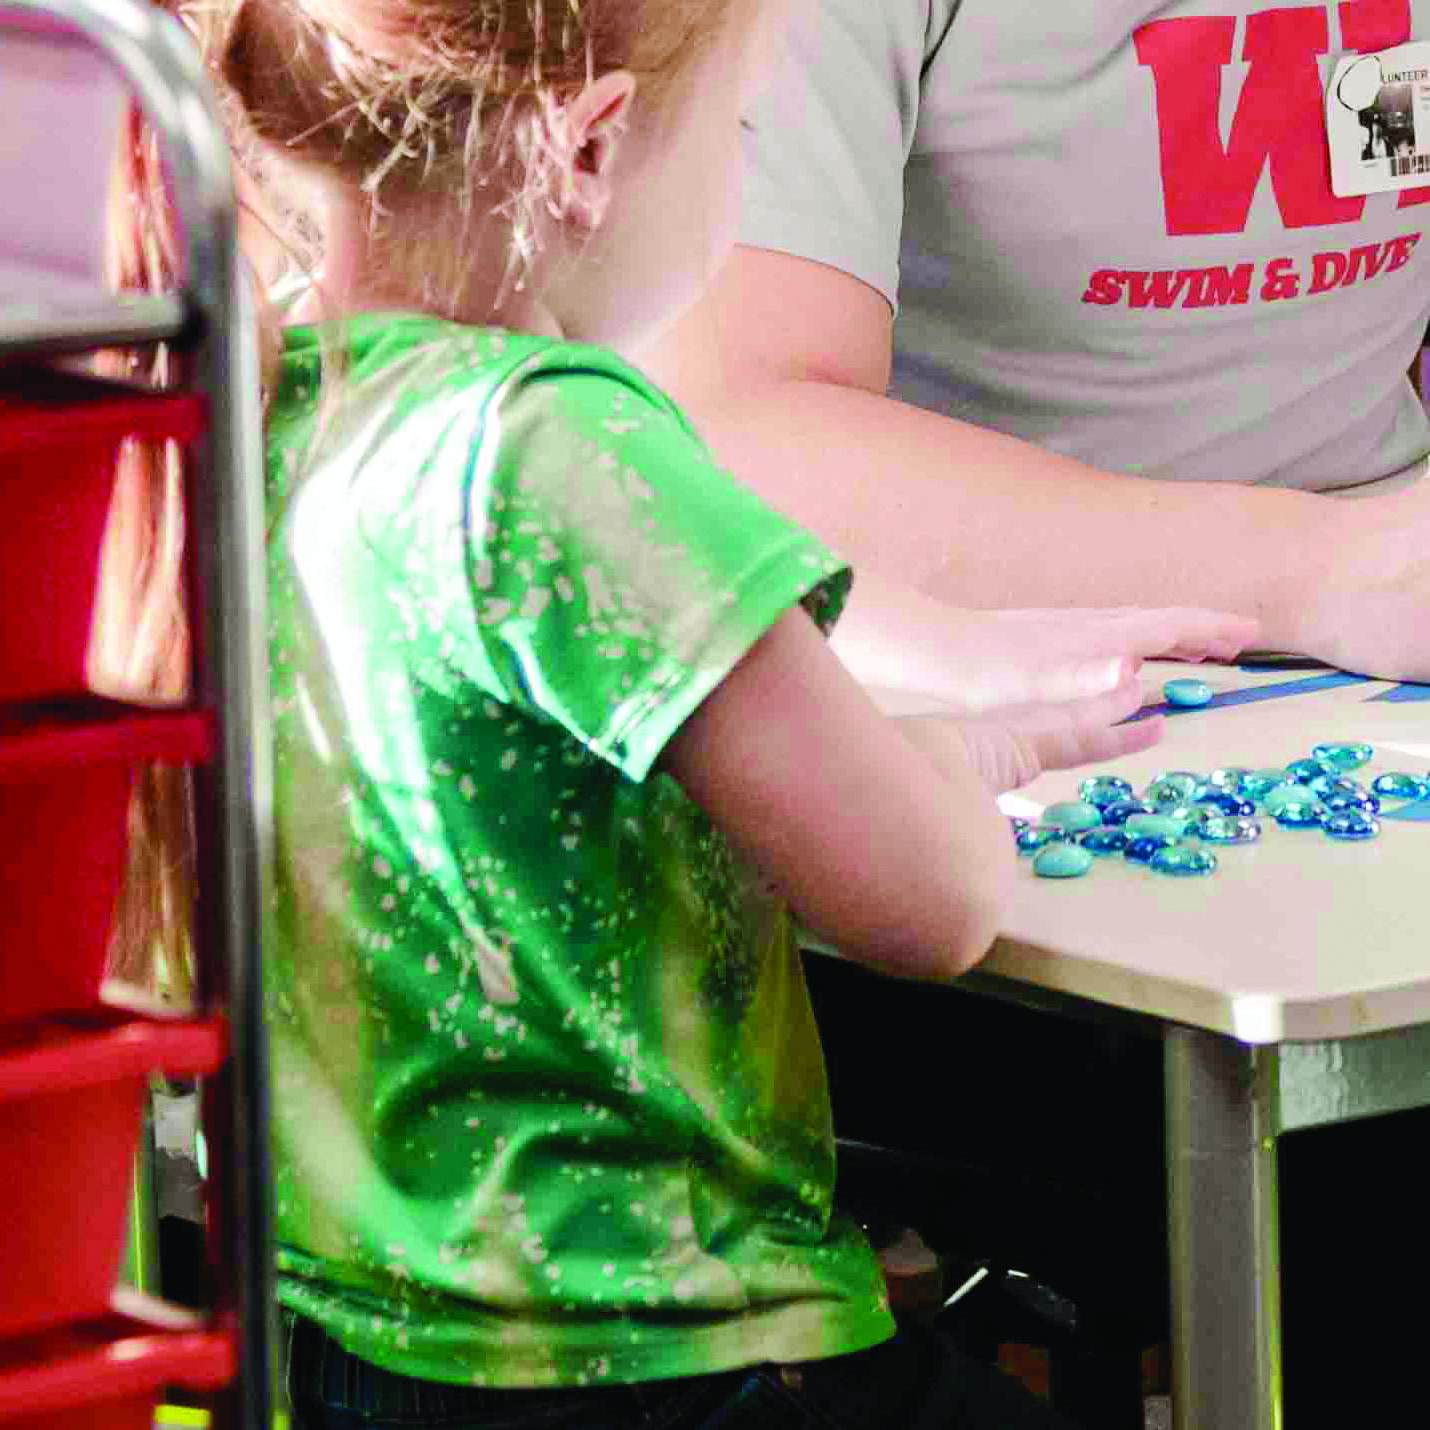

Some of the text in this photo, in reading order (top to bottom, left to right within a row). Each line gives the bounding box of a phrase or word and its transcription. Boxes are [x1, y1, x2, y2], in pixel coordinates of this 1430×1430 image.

[1081, 232, 1421, 309] SWIM & DIVE
